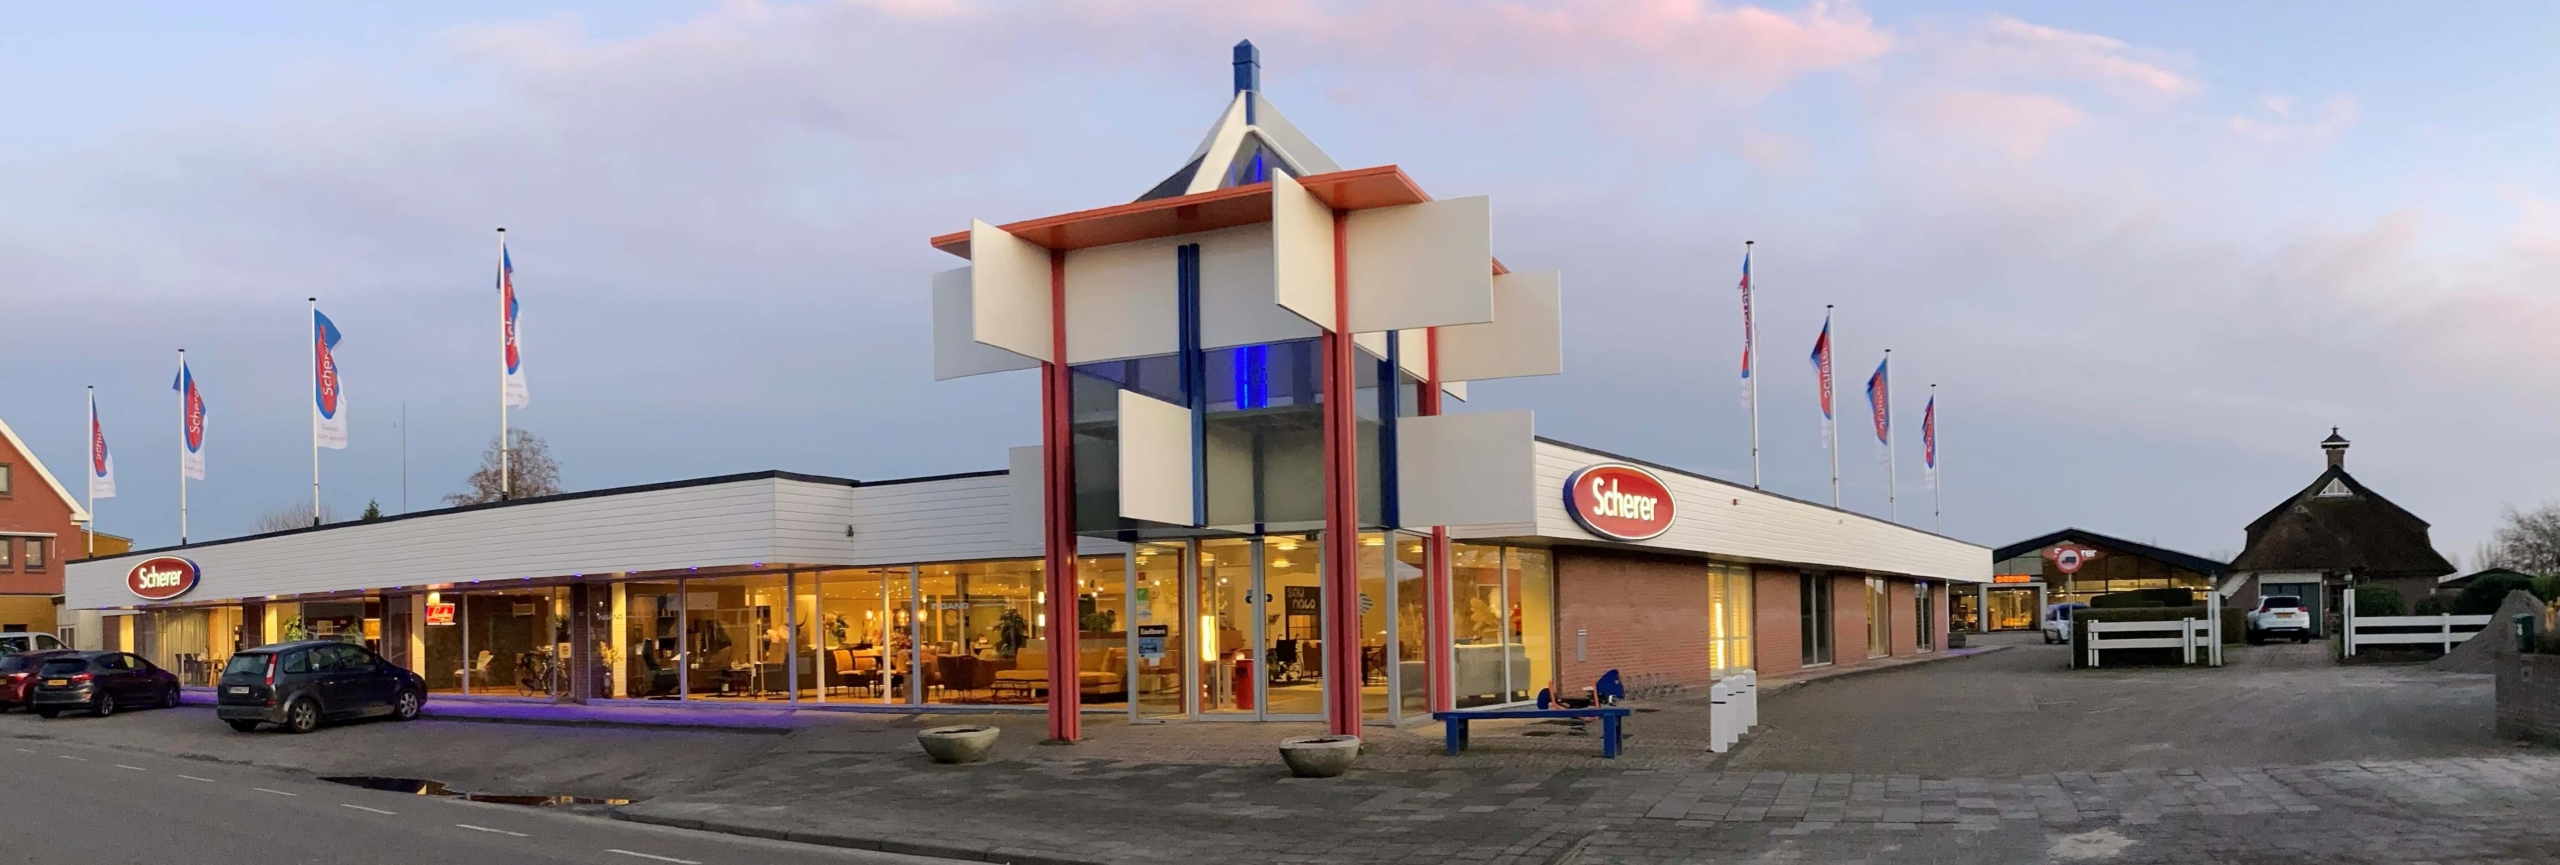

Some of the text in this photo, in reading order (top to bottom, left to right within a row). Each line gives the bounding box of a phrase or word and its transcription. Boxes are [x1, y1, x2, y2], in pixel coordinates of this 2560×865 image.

[1592, 477, 1657, 521] Scherer
[2053, 547, 2097, 558] Srer
[139, 565, 182, 590] Scherer
